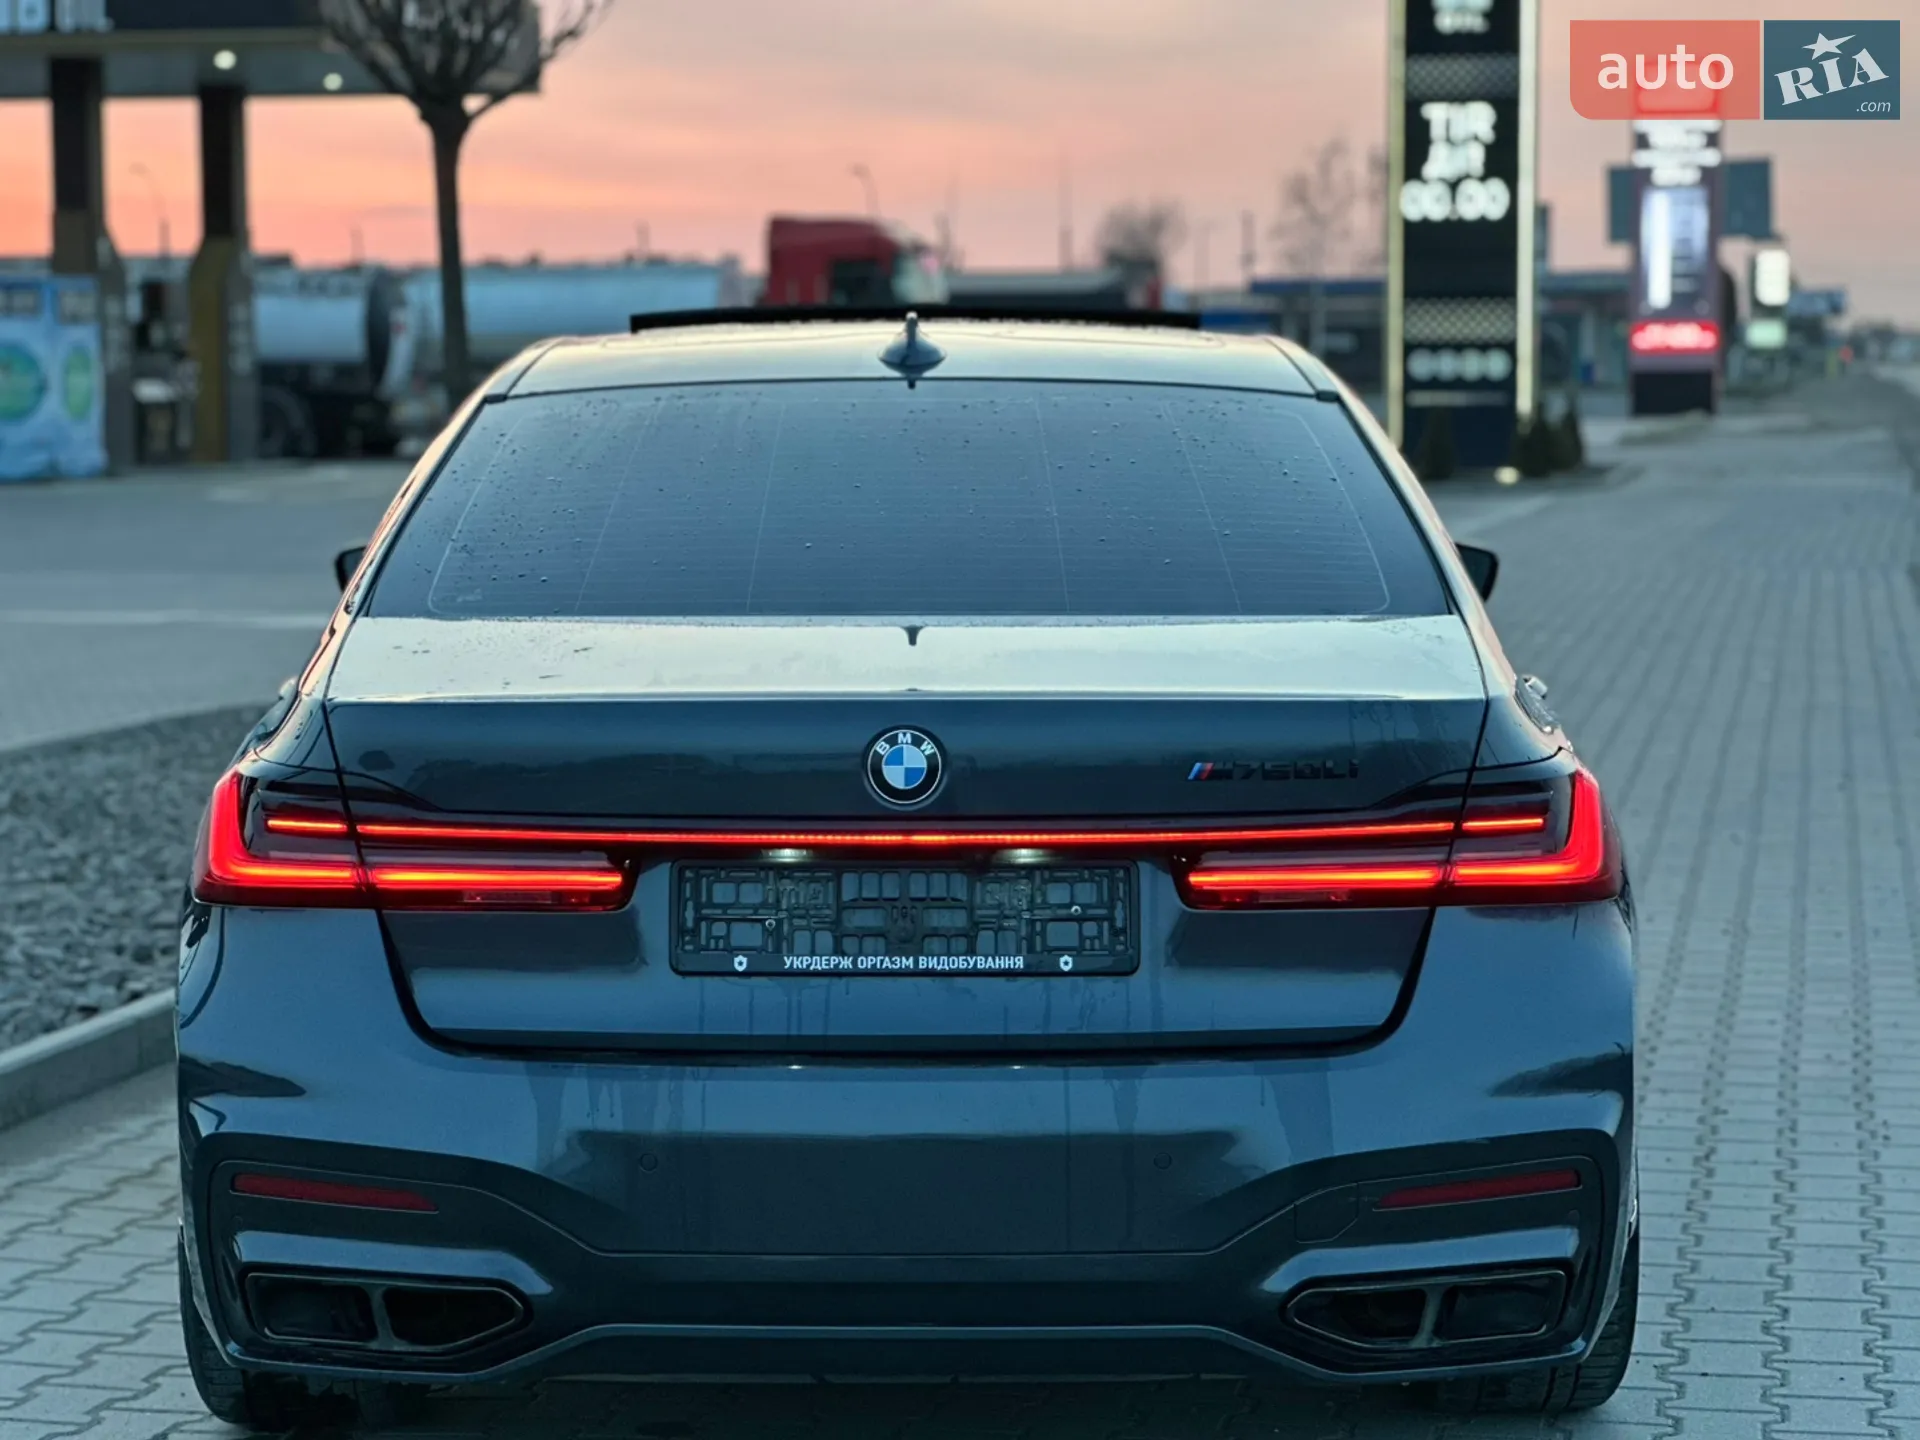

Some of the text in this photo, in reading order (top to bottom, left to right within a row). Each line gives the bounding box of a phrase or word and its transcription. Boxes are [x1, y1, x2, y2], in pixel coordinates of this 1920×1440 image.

[875, 732, 935, 756] BMW
[783, 956, 1024, 971] УКРДЕРЖ ОРГАЗМ ВИДОБУВАННЯ
